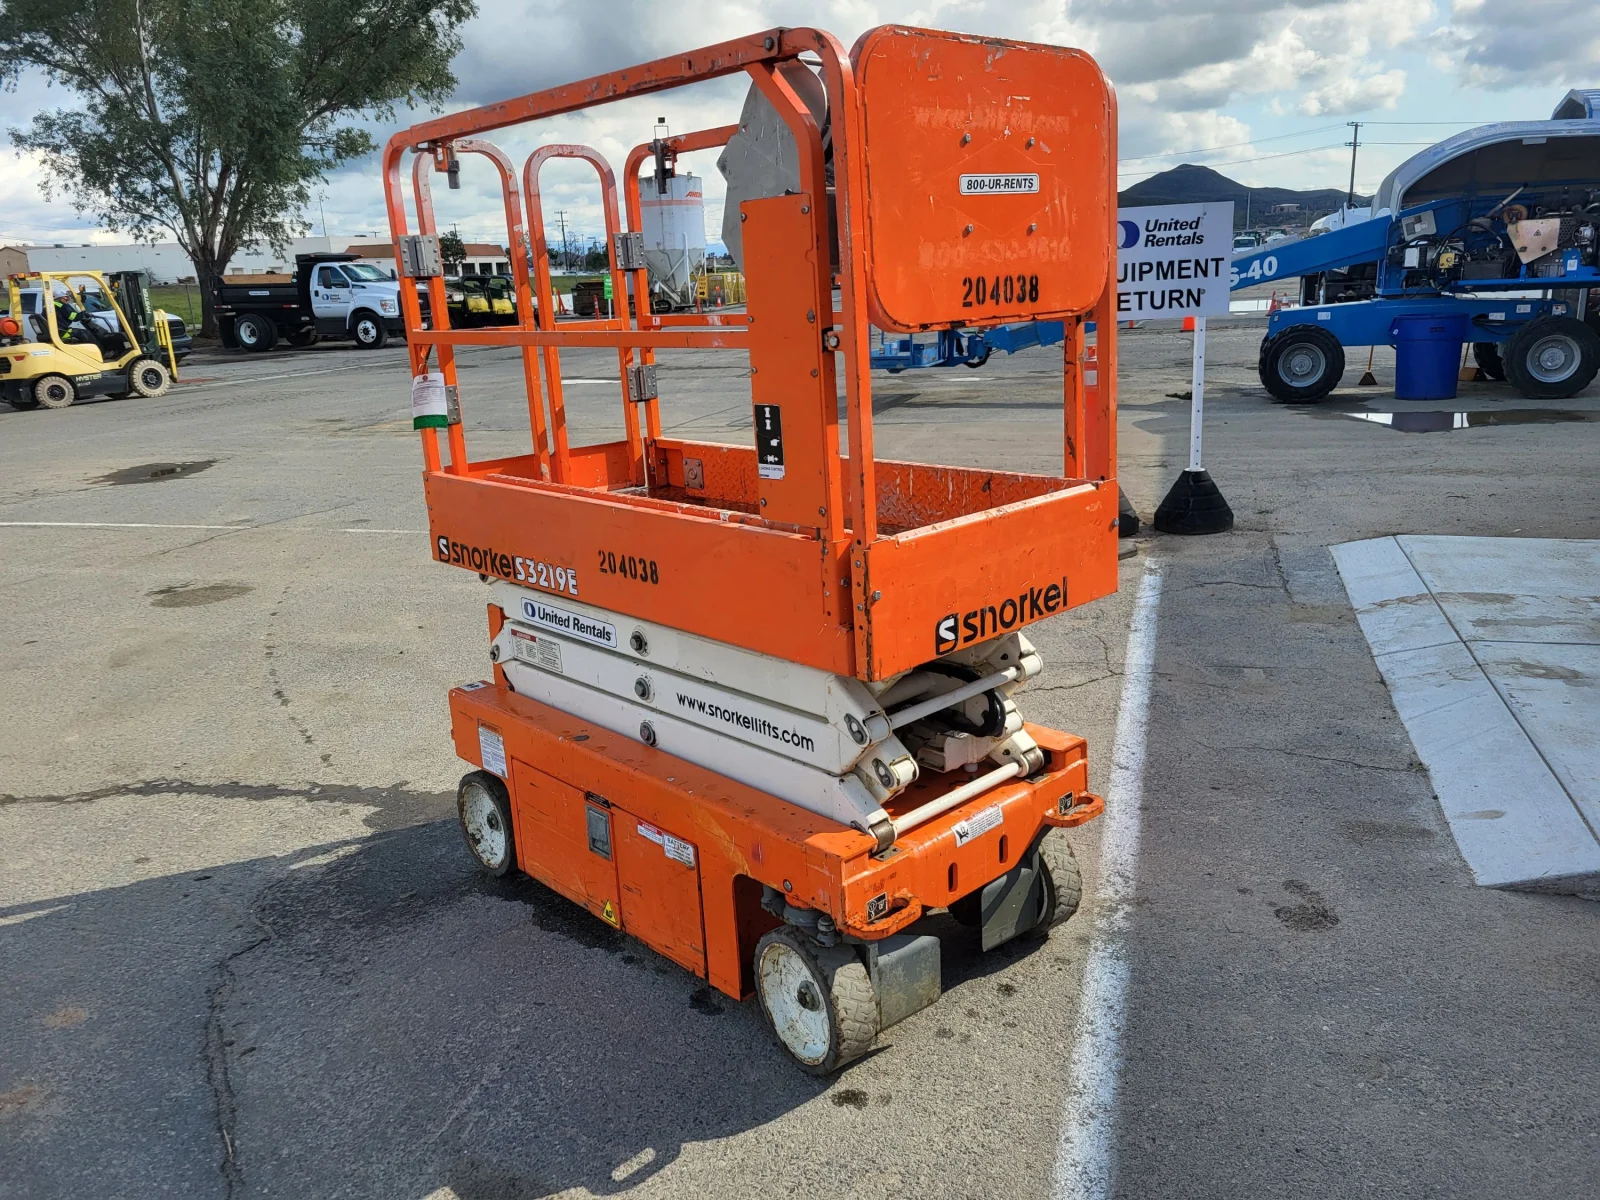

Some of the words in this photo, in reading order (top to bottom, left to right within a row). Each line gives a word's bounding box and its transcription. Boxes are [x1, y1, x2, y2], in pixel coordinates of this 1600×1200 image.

[966, 178, 1034, 191] 800-UR-RENTS
[1144, 231, 1205, 247] Rentals
[1145, 217, 1201, 232] United
[1117, 257, 1225, 283] UIPMENT
[1230, 256, 1278, 287] S-40
[142, 288, 151, 313] HYSTER
[962, 274, 1039, 307] 204038
[1117, 288, 1201, 311] ETURN
[75, 374, 102, 382] HYSTER
[451, 541, 517, 579] snorkel
[598, 550, 659, 585] 204038
[514, 556, 578, 596] S3219E
[537, 606, 570, 629] United
[572, 616, 612, 642] Rentals
[963, 576, 1068, 644] snorkel
[676, 692, 815, 752] www.snorkellifts.com
